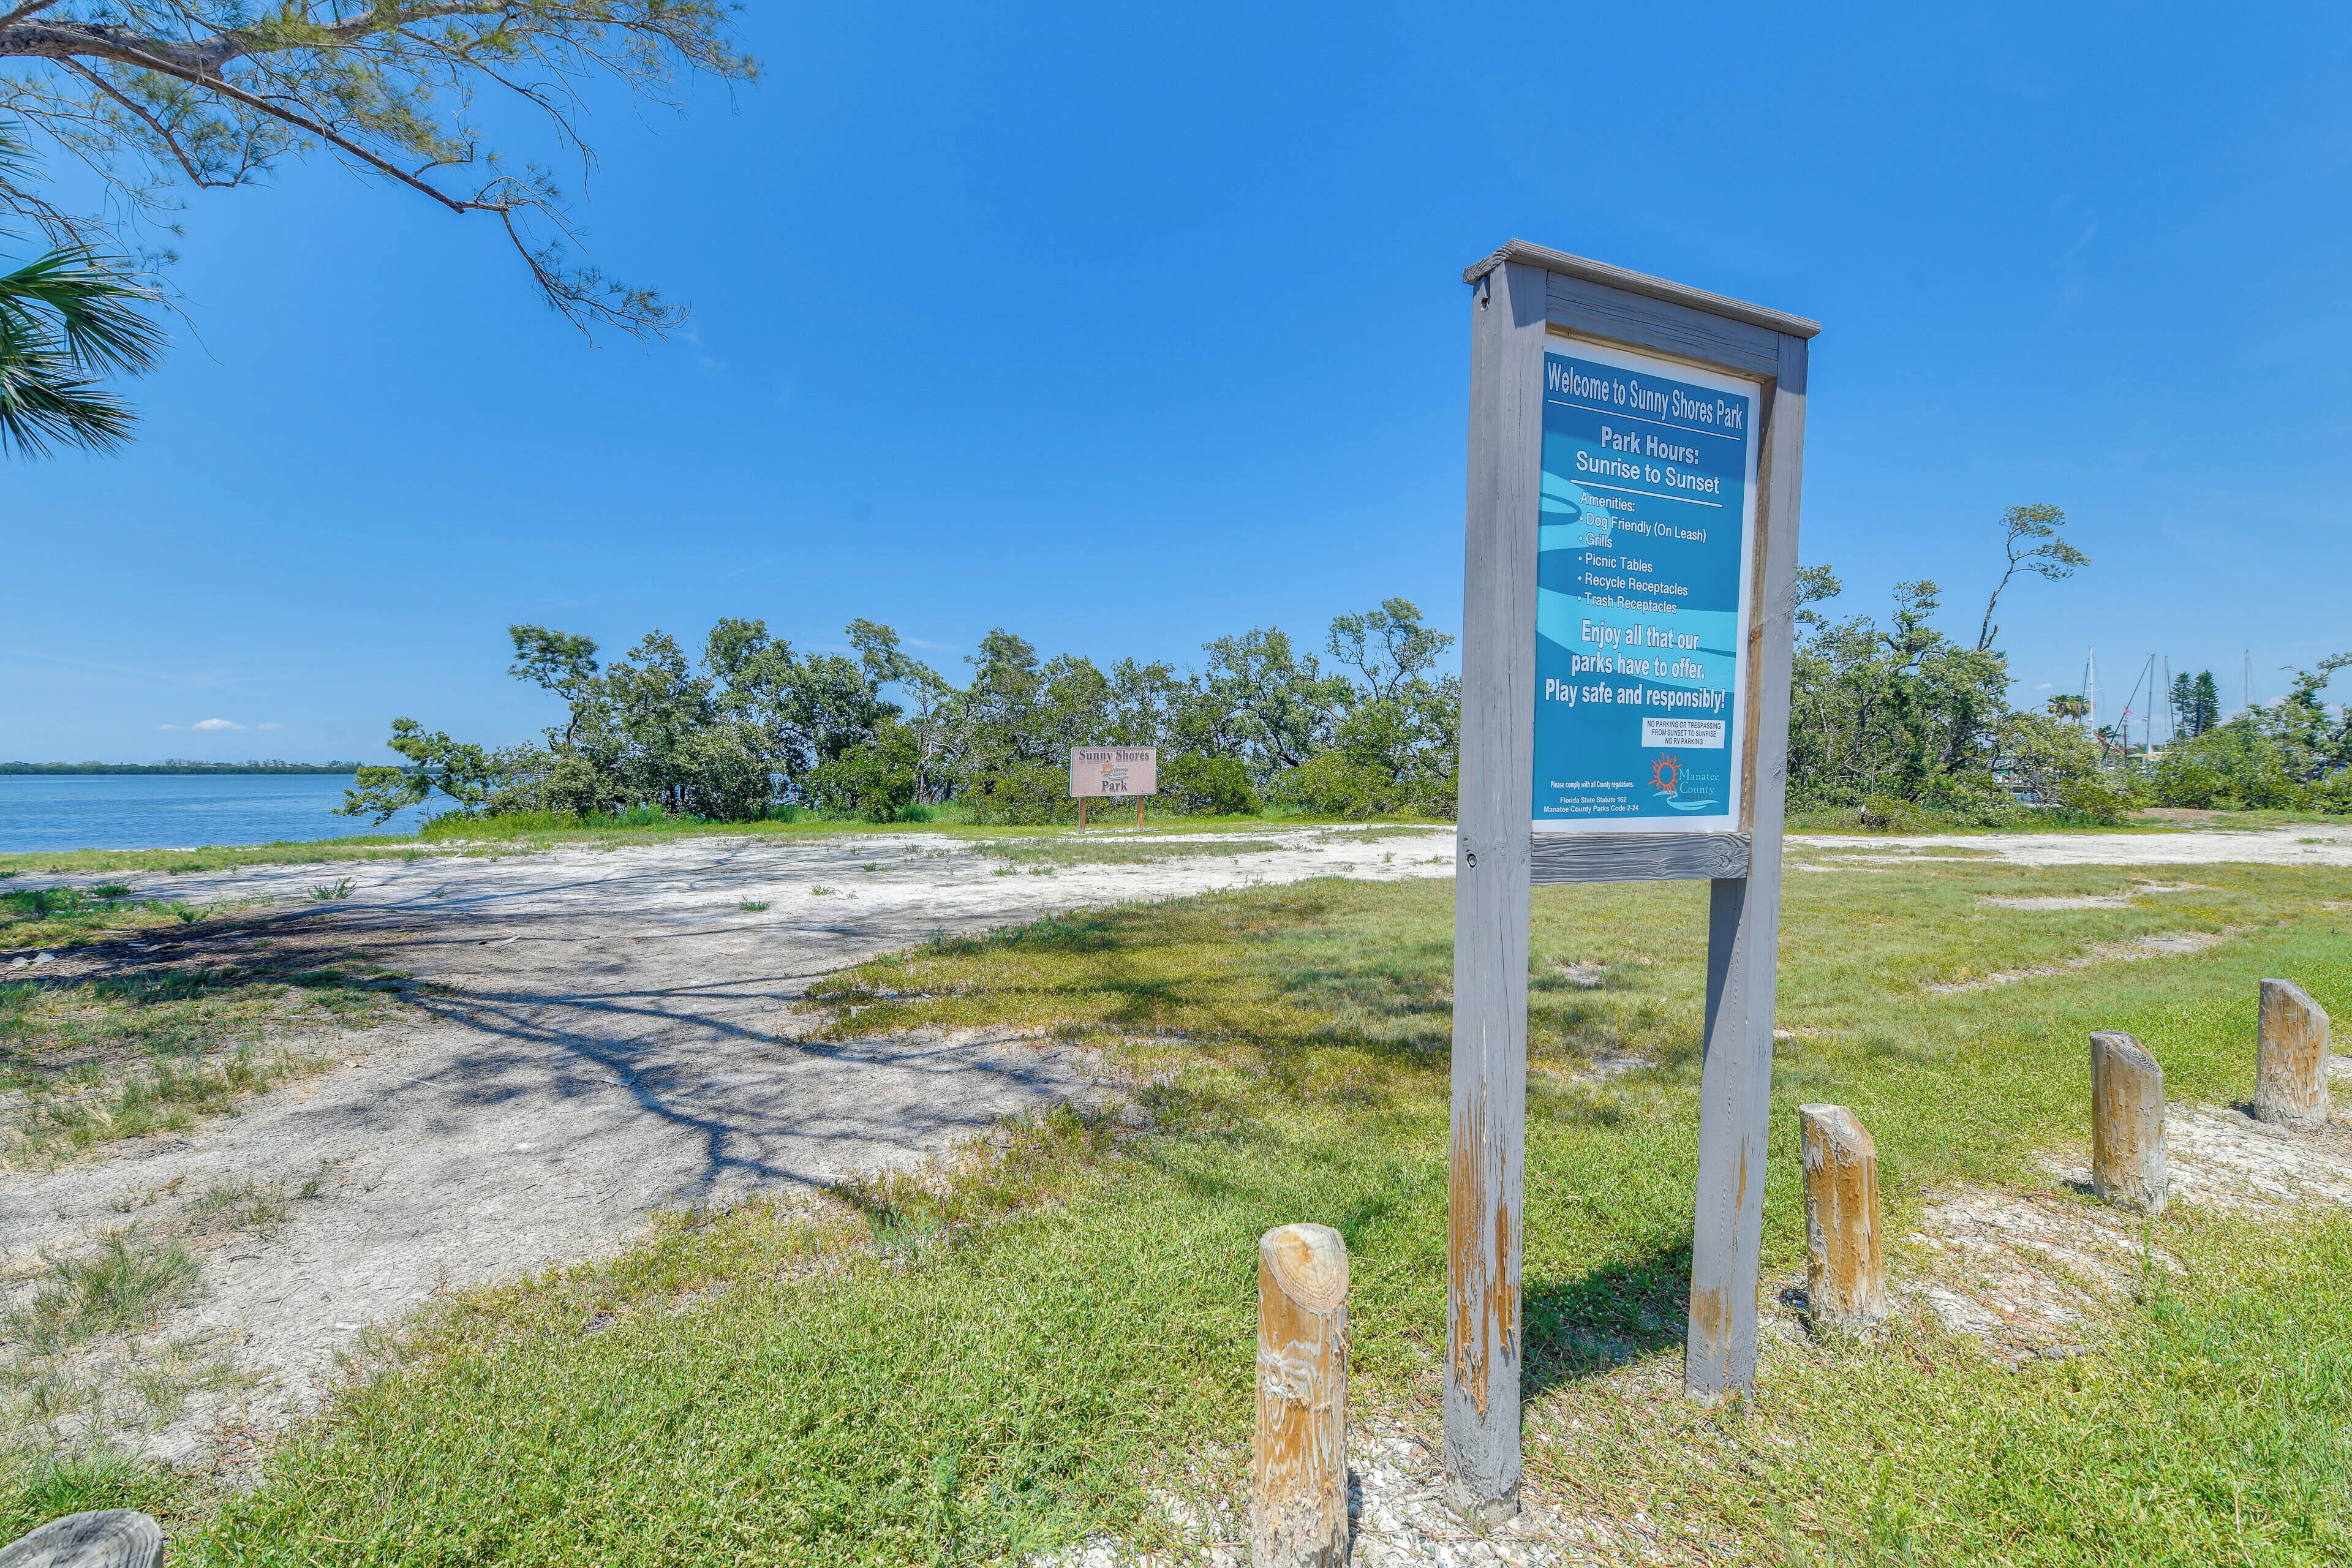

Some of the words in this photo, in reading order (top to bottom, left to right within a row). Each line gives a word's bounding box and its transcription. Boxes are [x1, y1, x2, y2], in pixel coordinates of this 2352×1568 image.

[1547, 361, 1610, 402] Welcome
[1613, 377, 1626, 405] to
[1630, 379, 1668, 421] Sunny
[1672, 389, 1713, 424] Shores
[1716, 399, 1743, 430] Park
[1601, 426, 1641, 454] Park
[1646, 435, 1699, 465] Hours:
[1576, 450, 1640, 480] Sunrise
[1645, 464, 1660, 483] to
[1665, 467, 1720, 494] Sunset
[1580, 492, 1635, 512] Amenities:
[1586, 513, 1608, 530] Dog
[1611, 516, 1651, 537] Friendly
[1654, 521, 1672, 538] (On
[1675, 527, 1706, 543] Leash)
[1586, 533, 1613, 548] Grills
[1585, 552, 1617, 568] Picnic
[1620, 557, 1653, 573] Tables
[1585, 573, 1626, 589] Recycle
[1629, 578, 1688, 596] Receptacles
[1585, 592, 1614, 608] Trash
[1617, 596, 1677, 614] Receptacles
[1581, 619, 1621, 649] Enjoy
[1625, 624, 1642, 646] all
[1646, 625, 1673, 649] that
[1677, 633, 1699, 650] our
[1572, 650, 1613, 676] parks
[1617, 653, 1649, 676] have
[1654, 656, 1668, 677] to
[1672, 657, 1705, 679] offer.
[1545, 679, 1578, 707] Play
[1582, 681, 1612, 704] safe
[1617, 684, 1642, 705] and
[1646, 688, 1725, 714] responsibly!
[1079, 750, 1112, 760] Sunny
[1116, 750, 1149, 760] Shores
[1101, 780, 1127, 790] Park
[1678, 769, 1719, 780] Manatee
[1680, 782, 1715, 795] County
